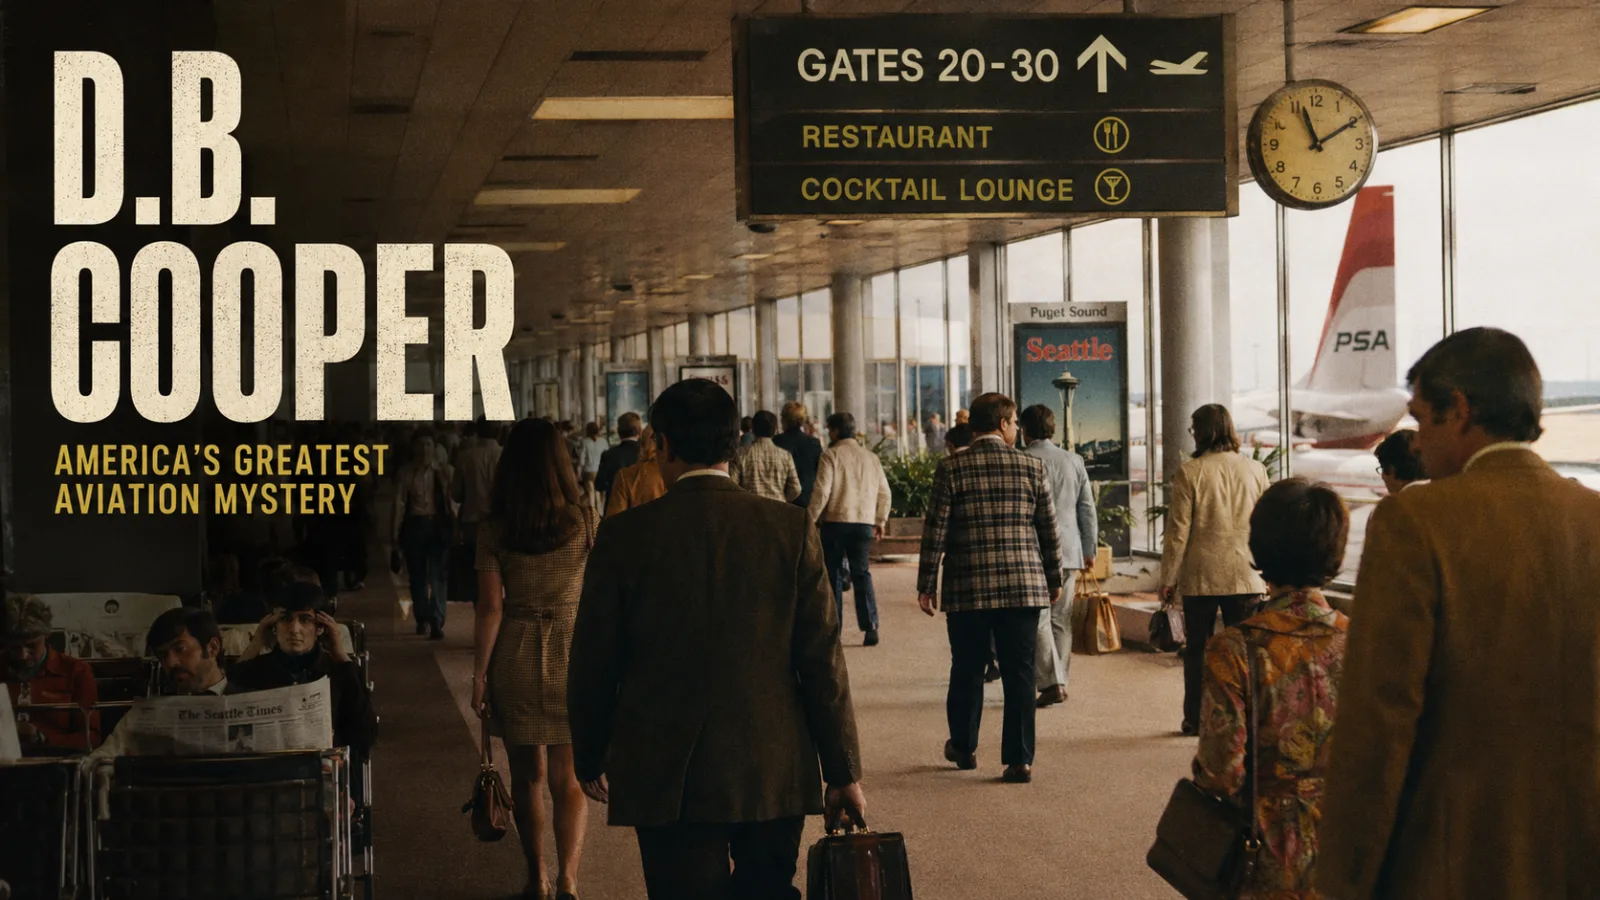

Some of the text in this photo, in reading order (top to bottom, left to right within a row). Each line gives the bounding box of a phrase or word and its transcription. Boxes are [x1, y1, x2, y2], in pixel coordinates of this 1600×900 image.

[797, 48, 1059, 83] GATES 20-30
[1309, 94, 1323, 107] 12
[803, 125, 993, 150] RESTAURANT
[1355, 138, 1364, 150] 3
[1269, 138, 1279, 151] 9
[1275, 160, 1285, 173] 8
[1348, 160, 1357, 172] 4
[1292, 176, 1300, 188] 7
[1312, 182, 1322, 194] 6
[1335, 176, 1344, 188] 5
[801, 178, 1074, 203] COCKTAIL LOUNGE
[1030, 306, 1107, 319] Puget Sound
[1334, 330, 1390, 352] PSA
[1026, 336, 1113, 362] Seattle
[178, 704, 283, 720] The Seattle Times
